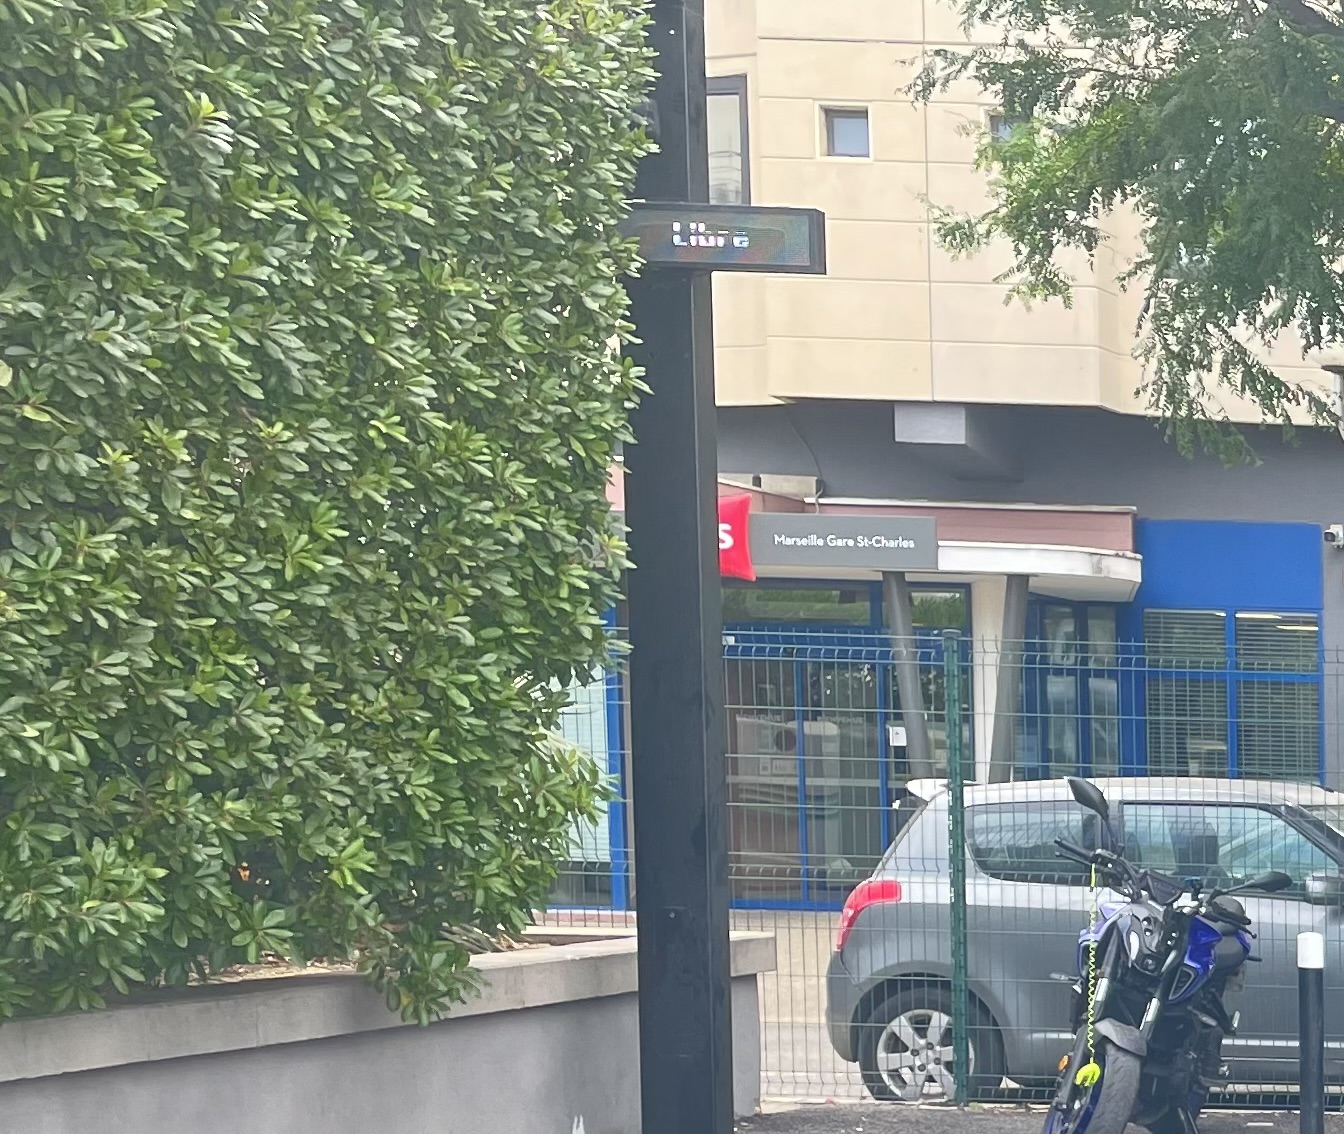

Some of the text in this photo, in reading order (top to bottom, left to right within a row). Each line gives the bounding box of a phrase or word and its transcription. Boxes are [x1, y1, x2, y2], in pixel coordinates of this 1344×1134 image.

[773, 534, 915, 548] Marseille Gare St-Charles
